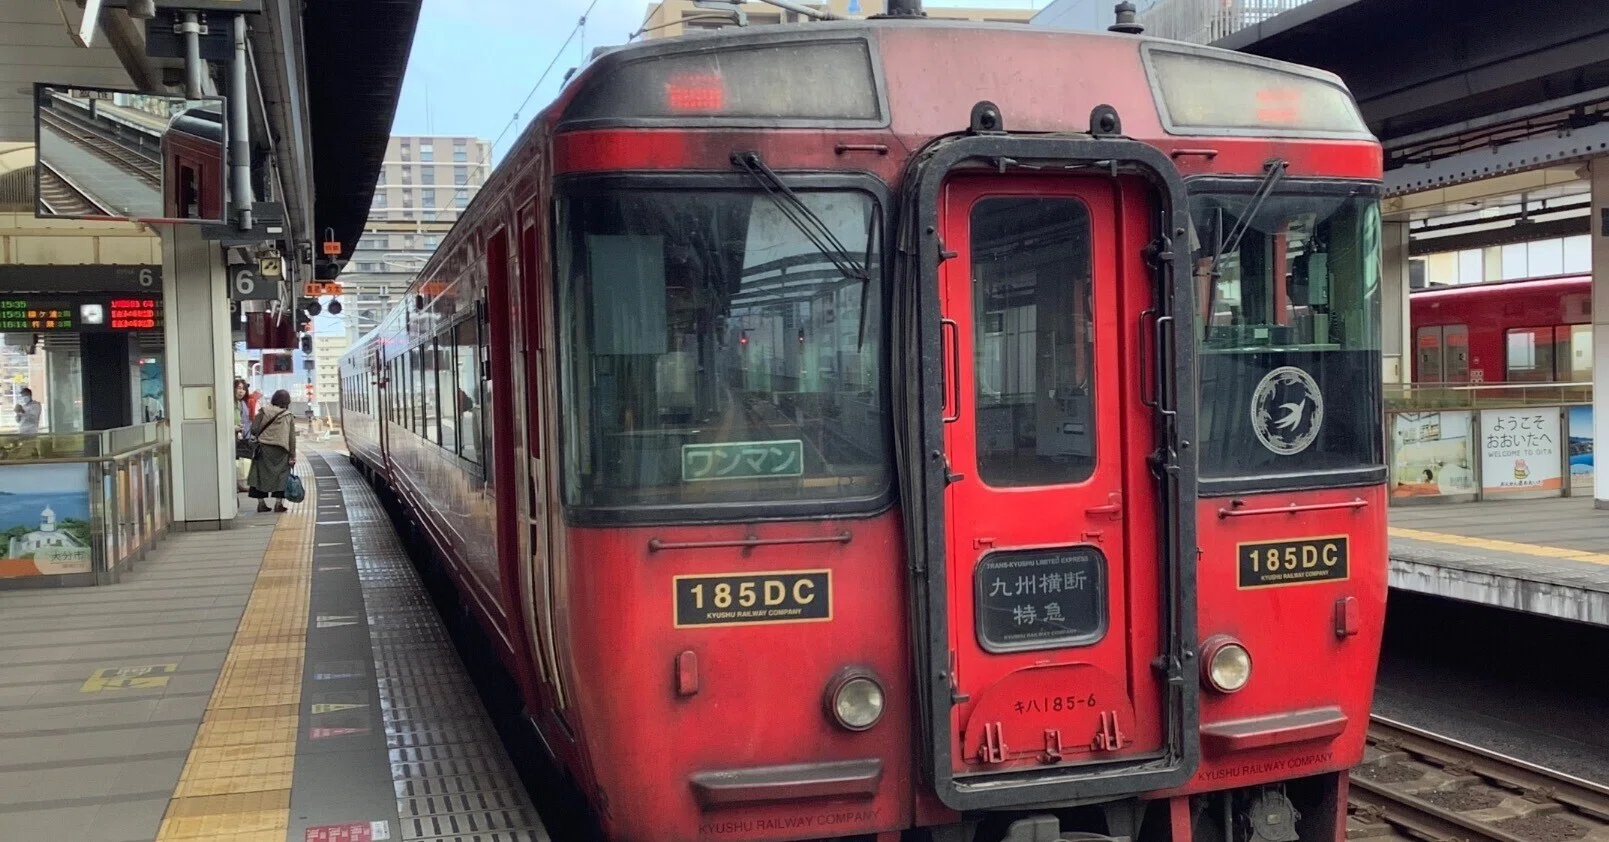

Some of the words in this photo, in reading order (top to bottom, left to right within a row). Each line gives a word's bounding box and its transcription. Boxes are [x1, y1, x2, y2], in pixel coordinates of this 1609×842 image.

[139, 268, 153, 287] 6
[236, 270, 254, 295] 6
[1, 300, 27, 309] 15:35
[1493, 415, 1545, 431] ようこそ
[1486, 432, 1553, 449] おおいたへ
[686, 447, 797, 477] ワンマン
[1488, 450, 1521, 458] WELCOME
[1535, 448, 1553, 456] OITA
[986, 560, 1035, 570] TRANS-KYUSHU
[1036, 557, 1060, 567] LIMITED
[1061, 555, 1089, 564] EXPRESS
[1248, 542, 1339, 573] 185DC
[988, 570, 1087, 597] 九州横断
[1260, 573, 1283, 581] KYUSHU
[1283, 572, 1305, 580] RAILWAY
[1305, 570, 1330, 578] COMPANY
[690, 578, 816, 609] 185DC
[706, 611, 736, 620] KYUSHU
[737, 609, 767, 618] RAILWAY
[768, 607, 803, 616] COMPANY
[1013, 601, 1066, 626] 特急
[1003, 632, 1026, 640] KYUSHU
[1197, 766, 1241, 782] KYUSHU
[1242, 760, 1285, 777] RAILWAY
[1287, 751, 1334, 770] COMPANY
[698, 820, 753, 836] KYUSHU
[756, 815, 814, 831] RAILWAY
[816, 809, 882, 826] COMPANY
